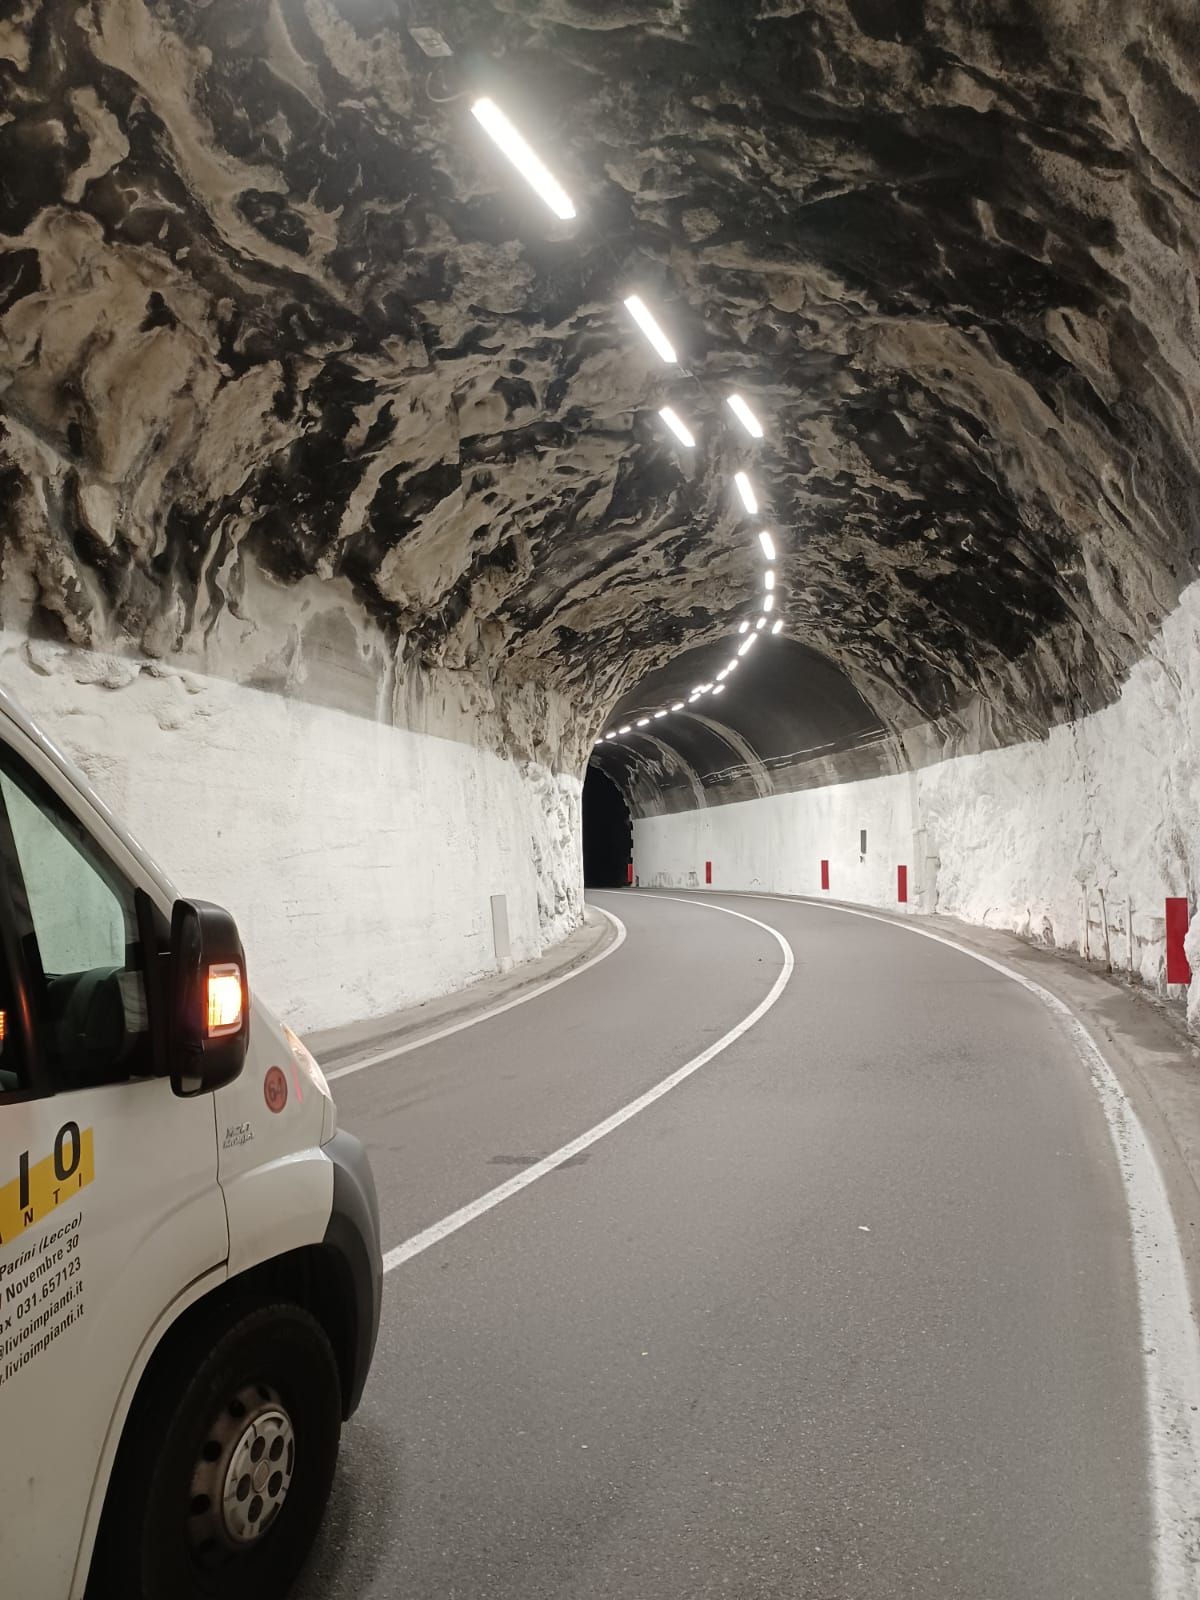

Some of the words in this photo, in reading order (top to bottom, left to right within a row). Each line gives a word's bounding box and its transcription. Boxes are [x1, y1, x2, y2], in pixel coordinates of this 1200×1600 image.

[0, 1244, 36, 1281] Parini
[39, 1212, 82, 1254] (Lecco)
[6, 1248, 64, 1303] Novembre
[66, 1234, 80, 1254] 30
[17, 1256, 81, 1320] 031.657123
